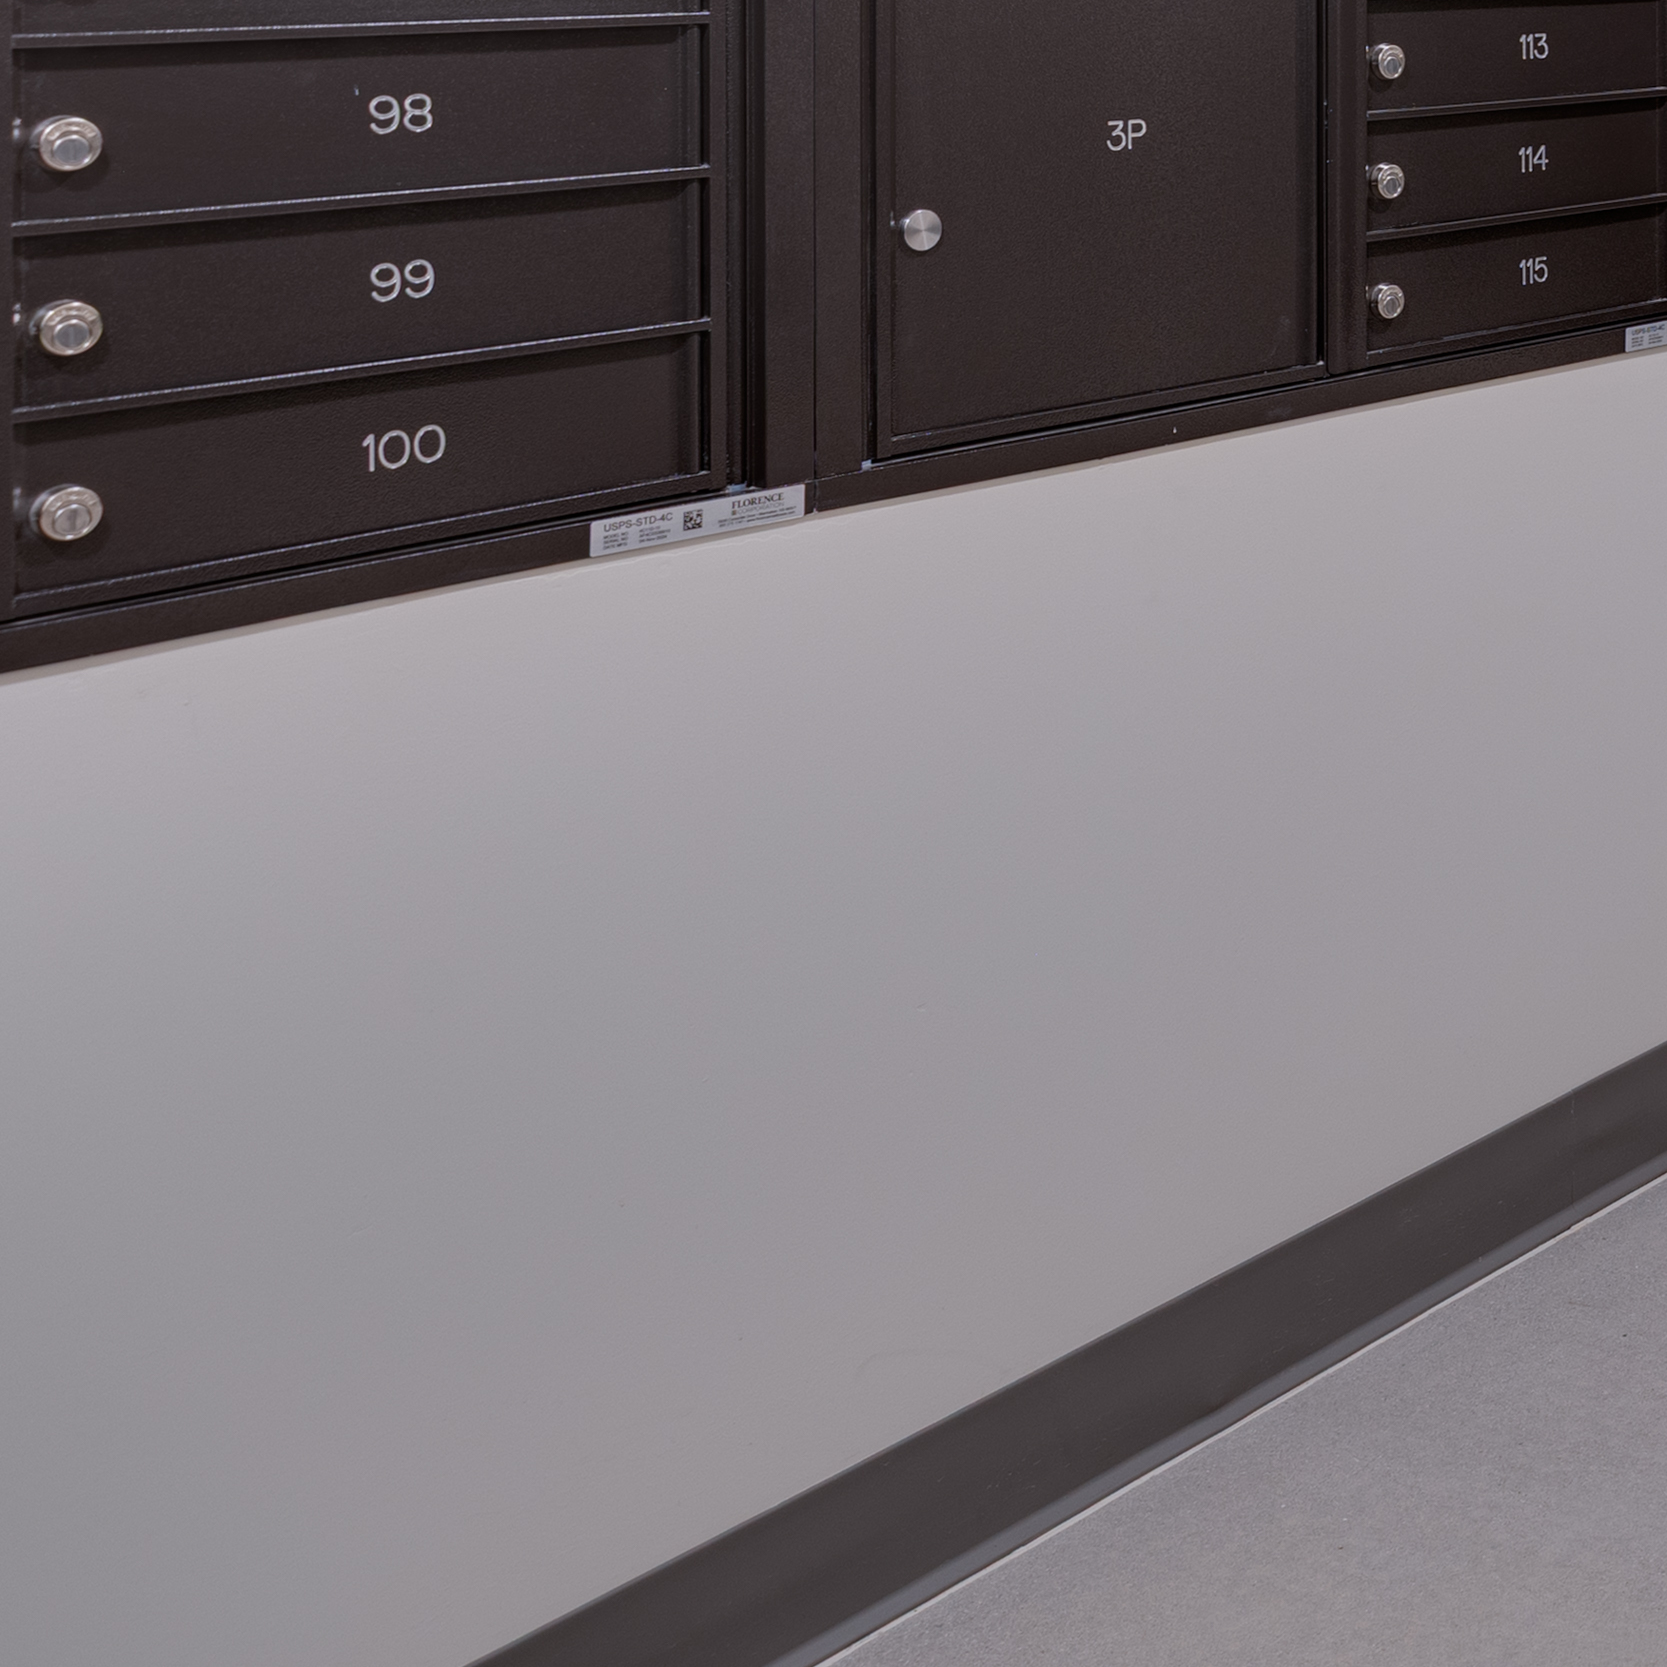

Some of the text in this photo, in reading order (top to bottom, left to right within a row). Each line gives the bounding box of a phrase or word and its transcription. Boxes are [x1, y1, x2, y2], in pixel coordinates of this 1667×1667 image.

[1519, 32, 1549, 60] 113
[368, 93, 433, 135] 98
[1106, 118, 1147, 152] 3P
[1518, 144, 1549, 173] 114
[370, 259, 435, 303] 99
[1519, 256, 1549, 286] 115
[361, 424, 446, 473] 100
[731, 492, 785, 510] FLORENCE
[603, 512, 673, 533] USPS-STD-4C
